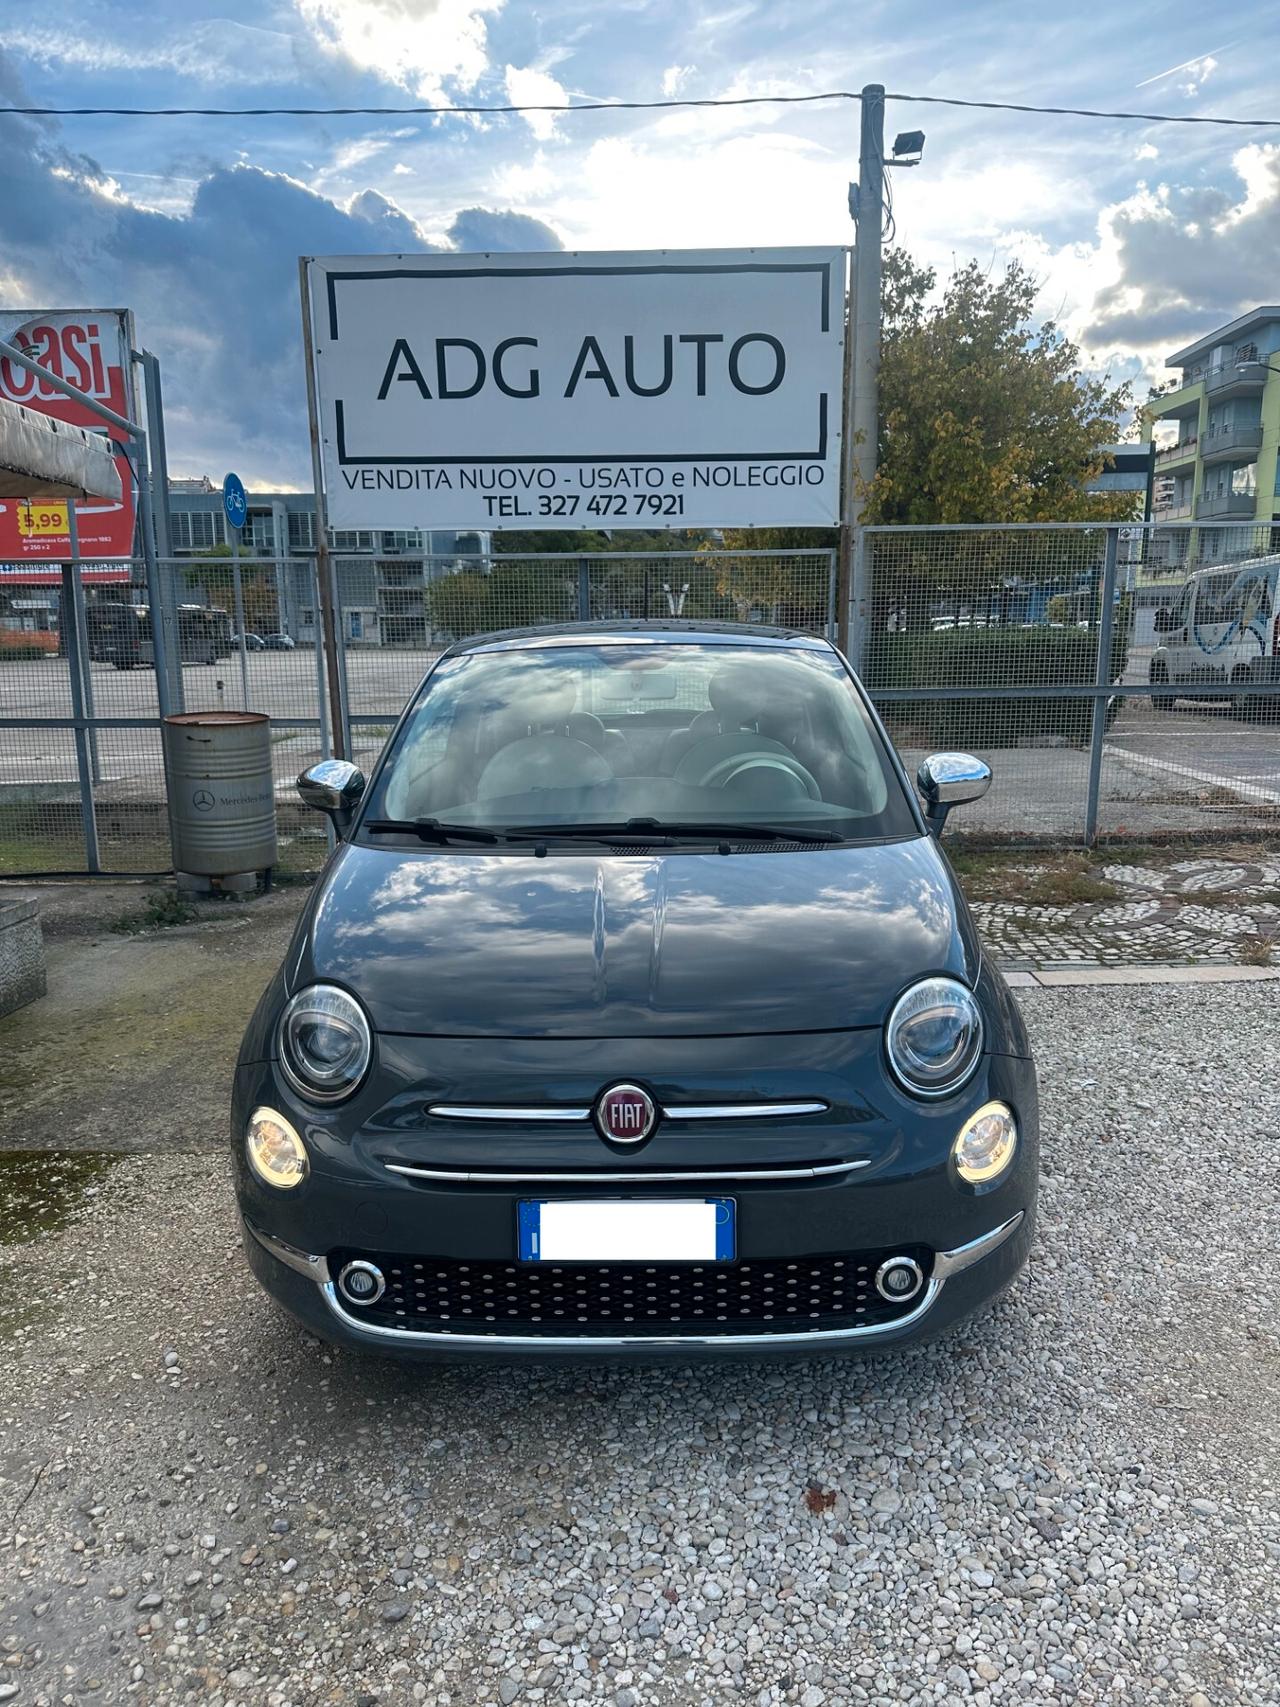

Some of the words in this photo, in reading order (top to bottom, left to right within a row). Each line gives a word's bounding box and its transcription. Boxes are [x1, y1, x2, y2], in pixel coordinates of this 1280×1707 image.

[377, 336, 540, 400] ADG
[563, 332, 787, 398] AUTO
[342, 469, 453, 490] VENDITA
[460, 468, 556, 489] NUOVO
[579, 467, 664, 489] USATO
[672, 472, 685, 487] e
[693, 465, 825, 487] NOLEGGIO
[482, 495, 532, 516] TEL.
[538, 495, 580, 515] 327
[586, 494, 627, 515] 472
[633, 494, 684, 515] 7921
[23, 513, 62, 530] 5,99
[611, 1103, 643, 1129] FIAT
